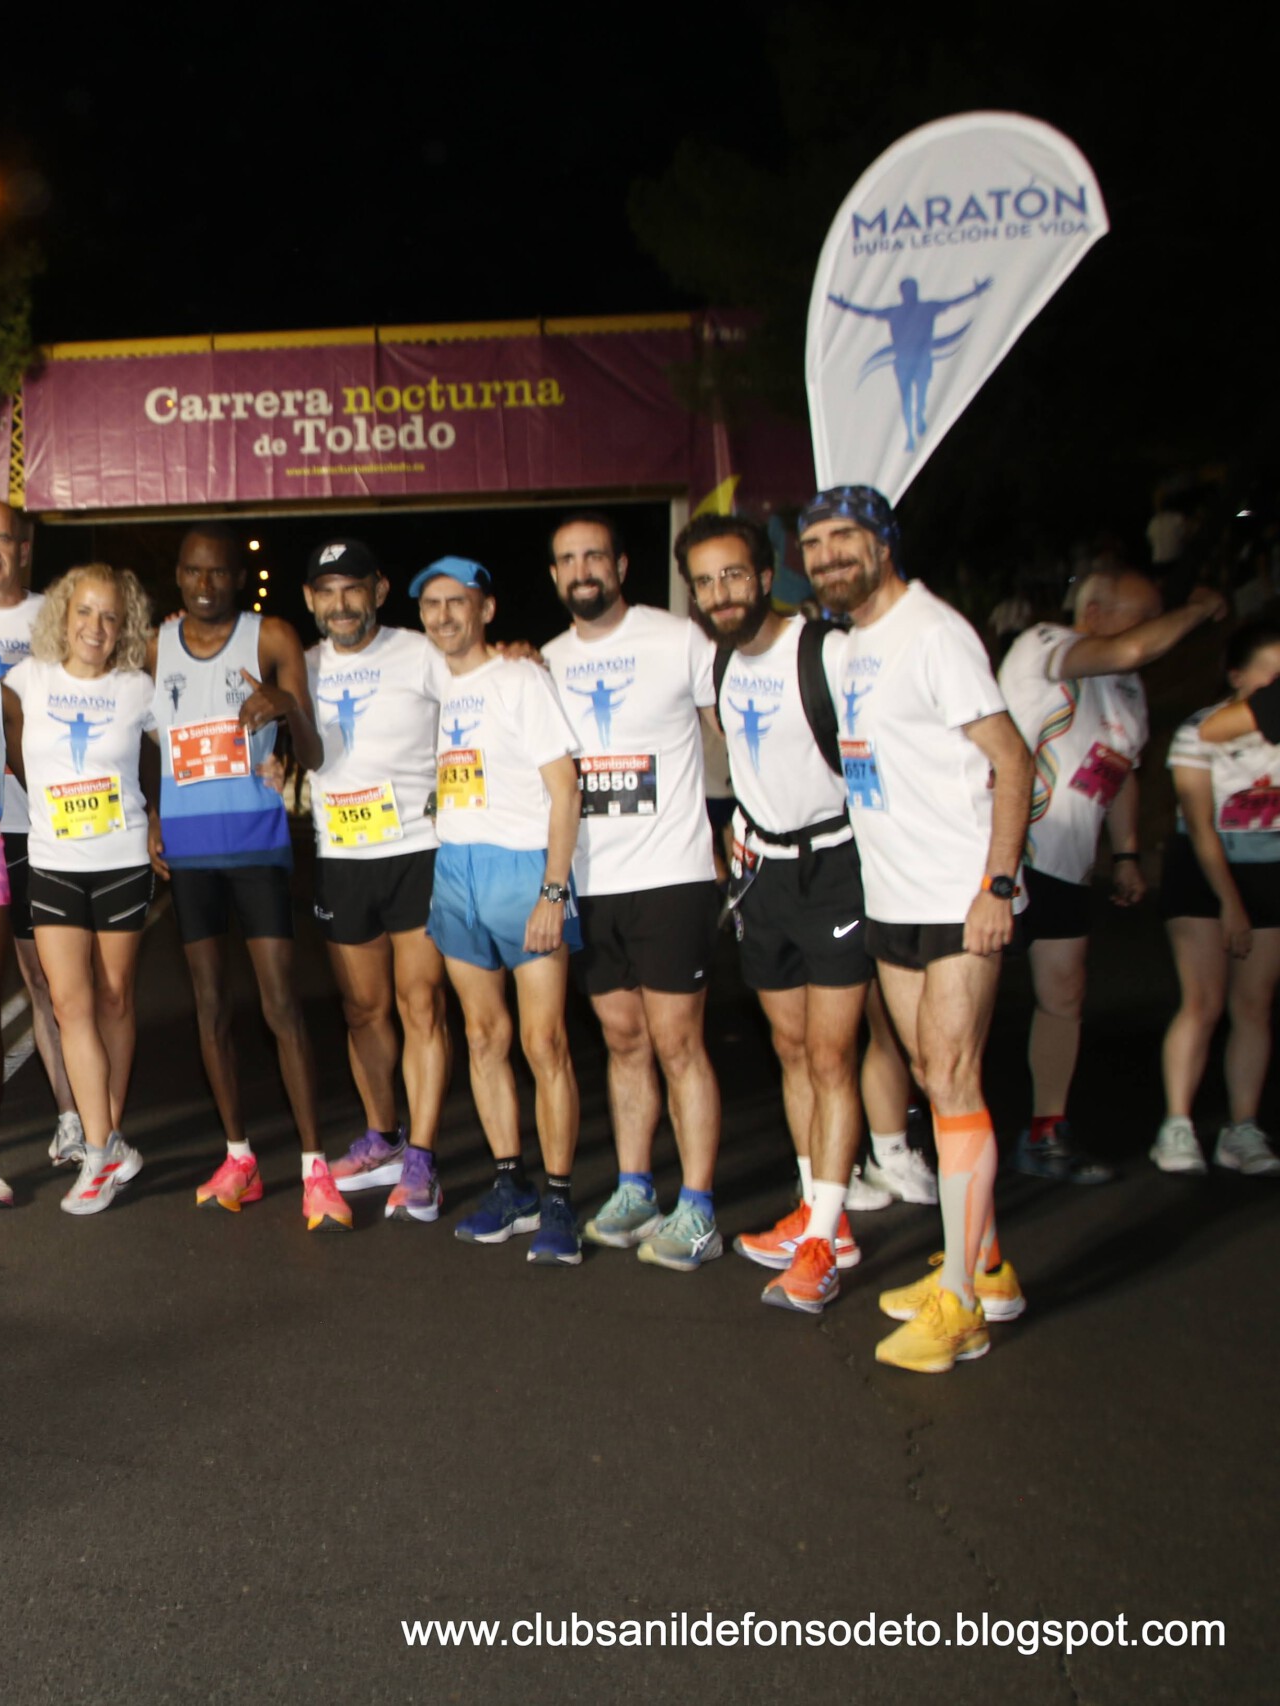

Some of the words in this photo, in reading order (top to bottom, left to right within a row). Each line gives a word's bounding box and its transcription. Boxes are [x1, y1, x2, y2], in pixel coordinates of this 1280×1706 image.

[852, 176, 1088, 239] MARATÓN
[853, 238, 904, 257] PURA
[1005, 222, 1033, 240] DE
[1039, 219, 1090, 236] VIDA
[144, 386, 333, 425] Carrera
[342, 375, 566, 415] nocturna
[253, 433, 287, 457] de
[293, 415, 457, 455] Toledo
[200, 737, 211, 755] 2
[592, 757, 649, 771] Santander
[64, 781, 111, 794] Santander
[586, 771, 638, 792] 5550
[64, 796, 99, 814] 890
[339, 807, 371, 824] 356
